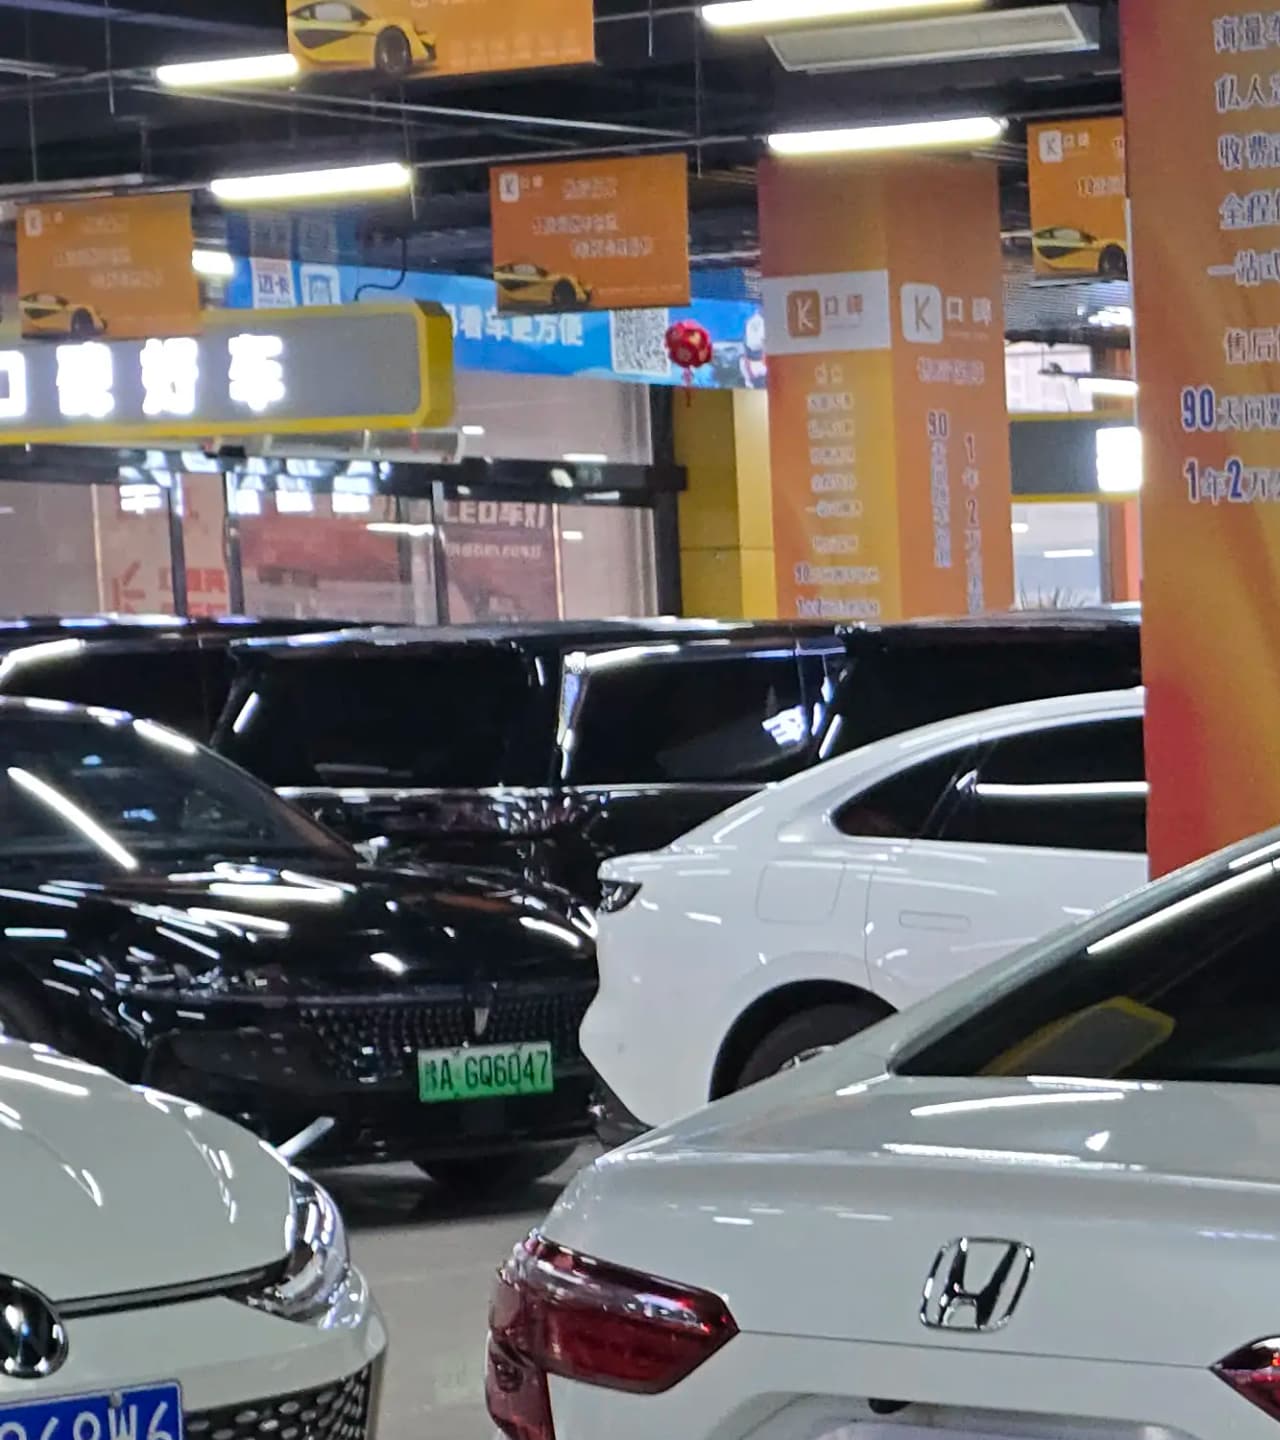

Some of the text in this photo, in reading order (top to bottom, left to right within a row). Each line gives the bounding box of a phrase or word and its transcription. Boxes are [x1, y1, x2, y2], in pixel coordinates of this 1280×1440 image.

[446, 304, 585, 347] 看车更方便
